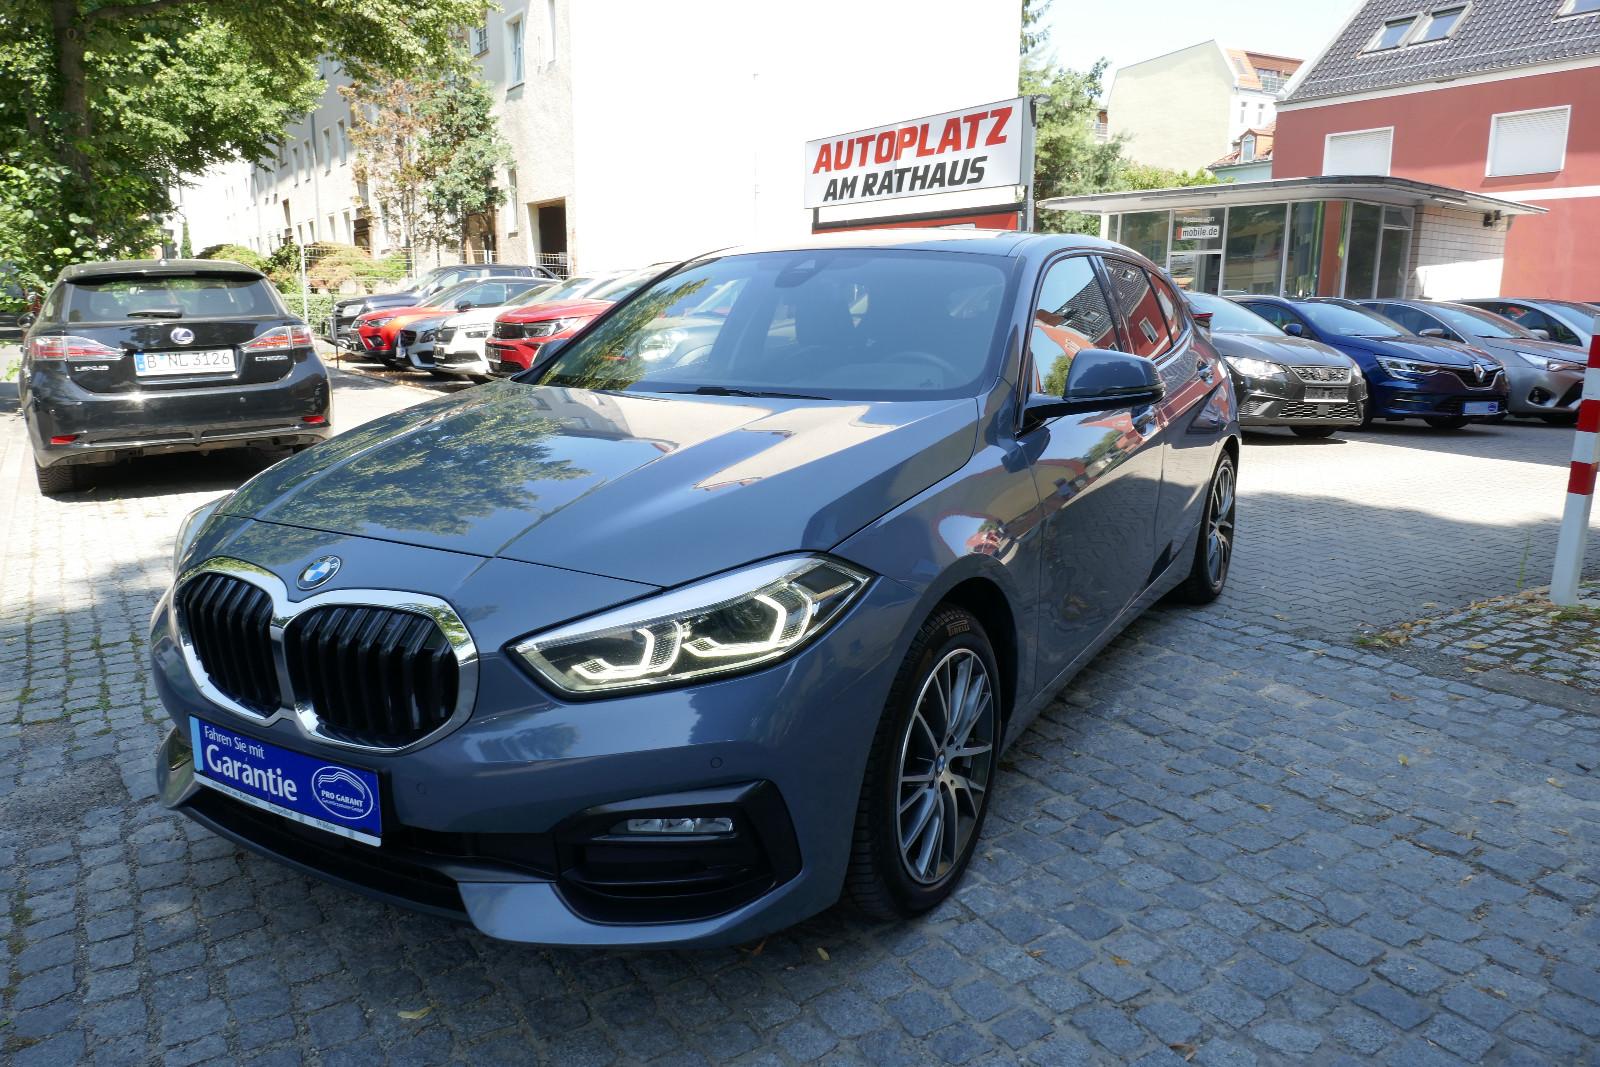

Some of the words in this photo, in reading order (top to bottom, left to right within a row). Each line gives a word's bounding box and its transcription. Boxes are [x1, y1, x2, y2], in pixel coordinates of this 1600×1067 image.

[812, 106, 1013, 174] AUTOPLATZ
[823, 175, 859, 202] AM
[861, 155, 988, 197] RATHAUS
[1183, 226, 1218, 237] mobile.de
[147, 354, 157, 368] B
[168, 353, 188, 367] NL
[192, 352, 230, 366] 3126
[204, 725, 232, 746] Fahren
[234, 736, 247, 752] Sie
[249, 744, 265, 760] mit
[206, 744, 298, 801] Garantie
[321, 789, 335, 800] PRO
[335, 794, 364, 807] GARANT
